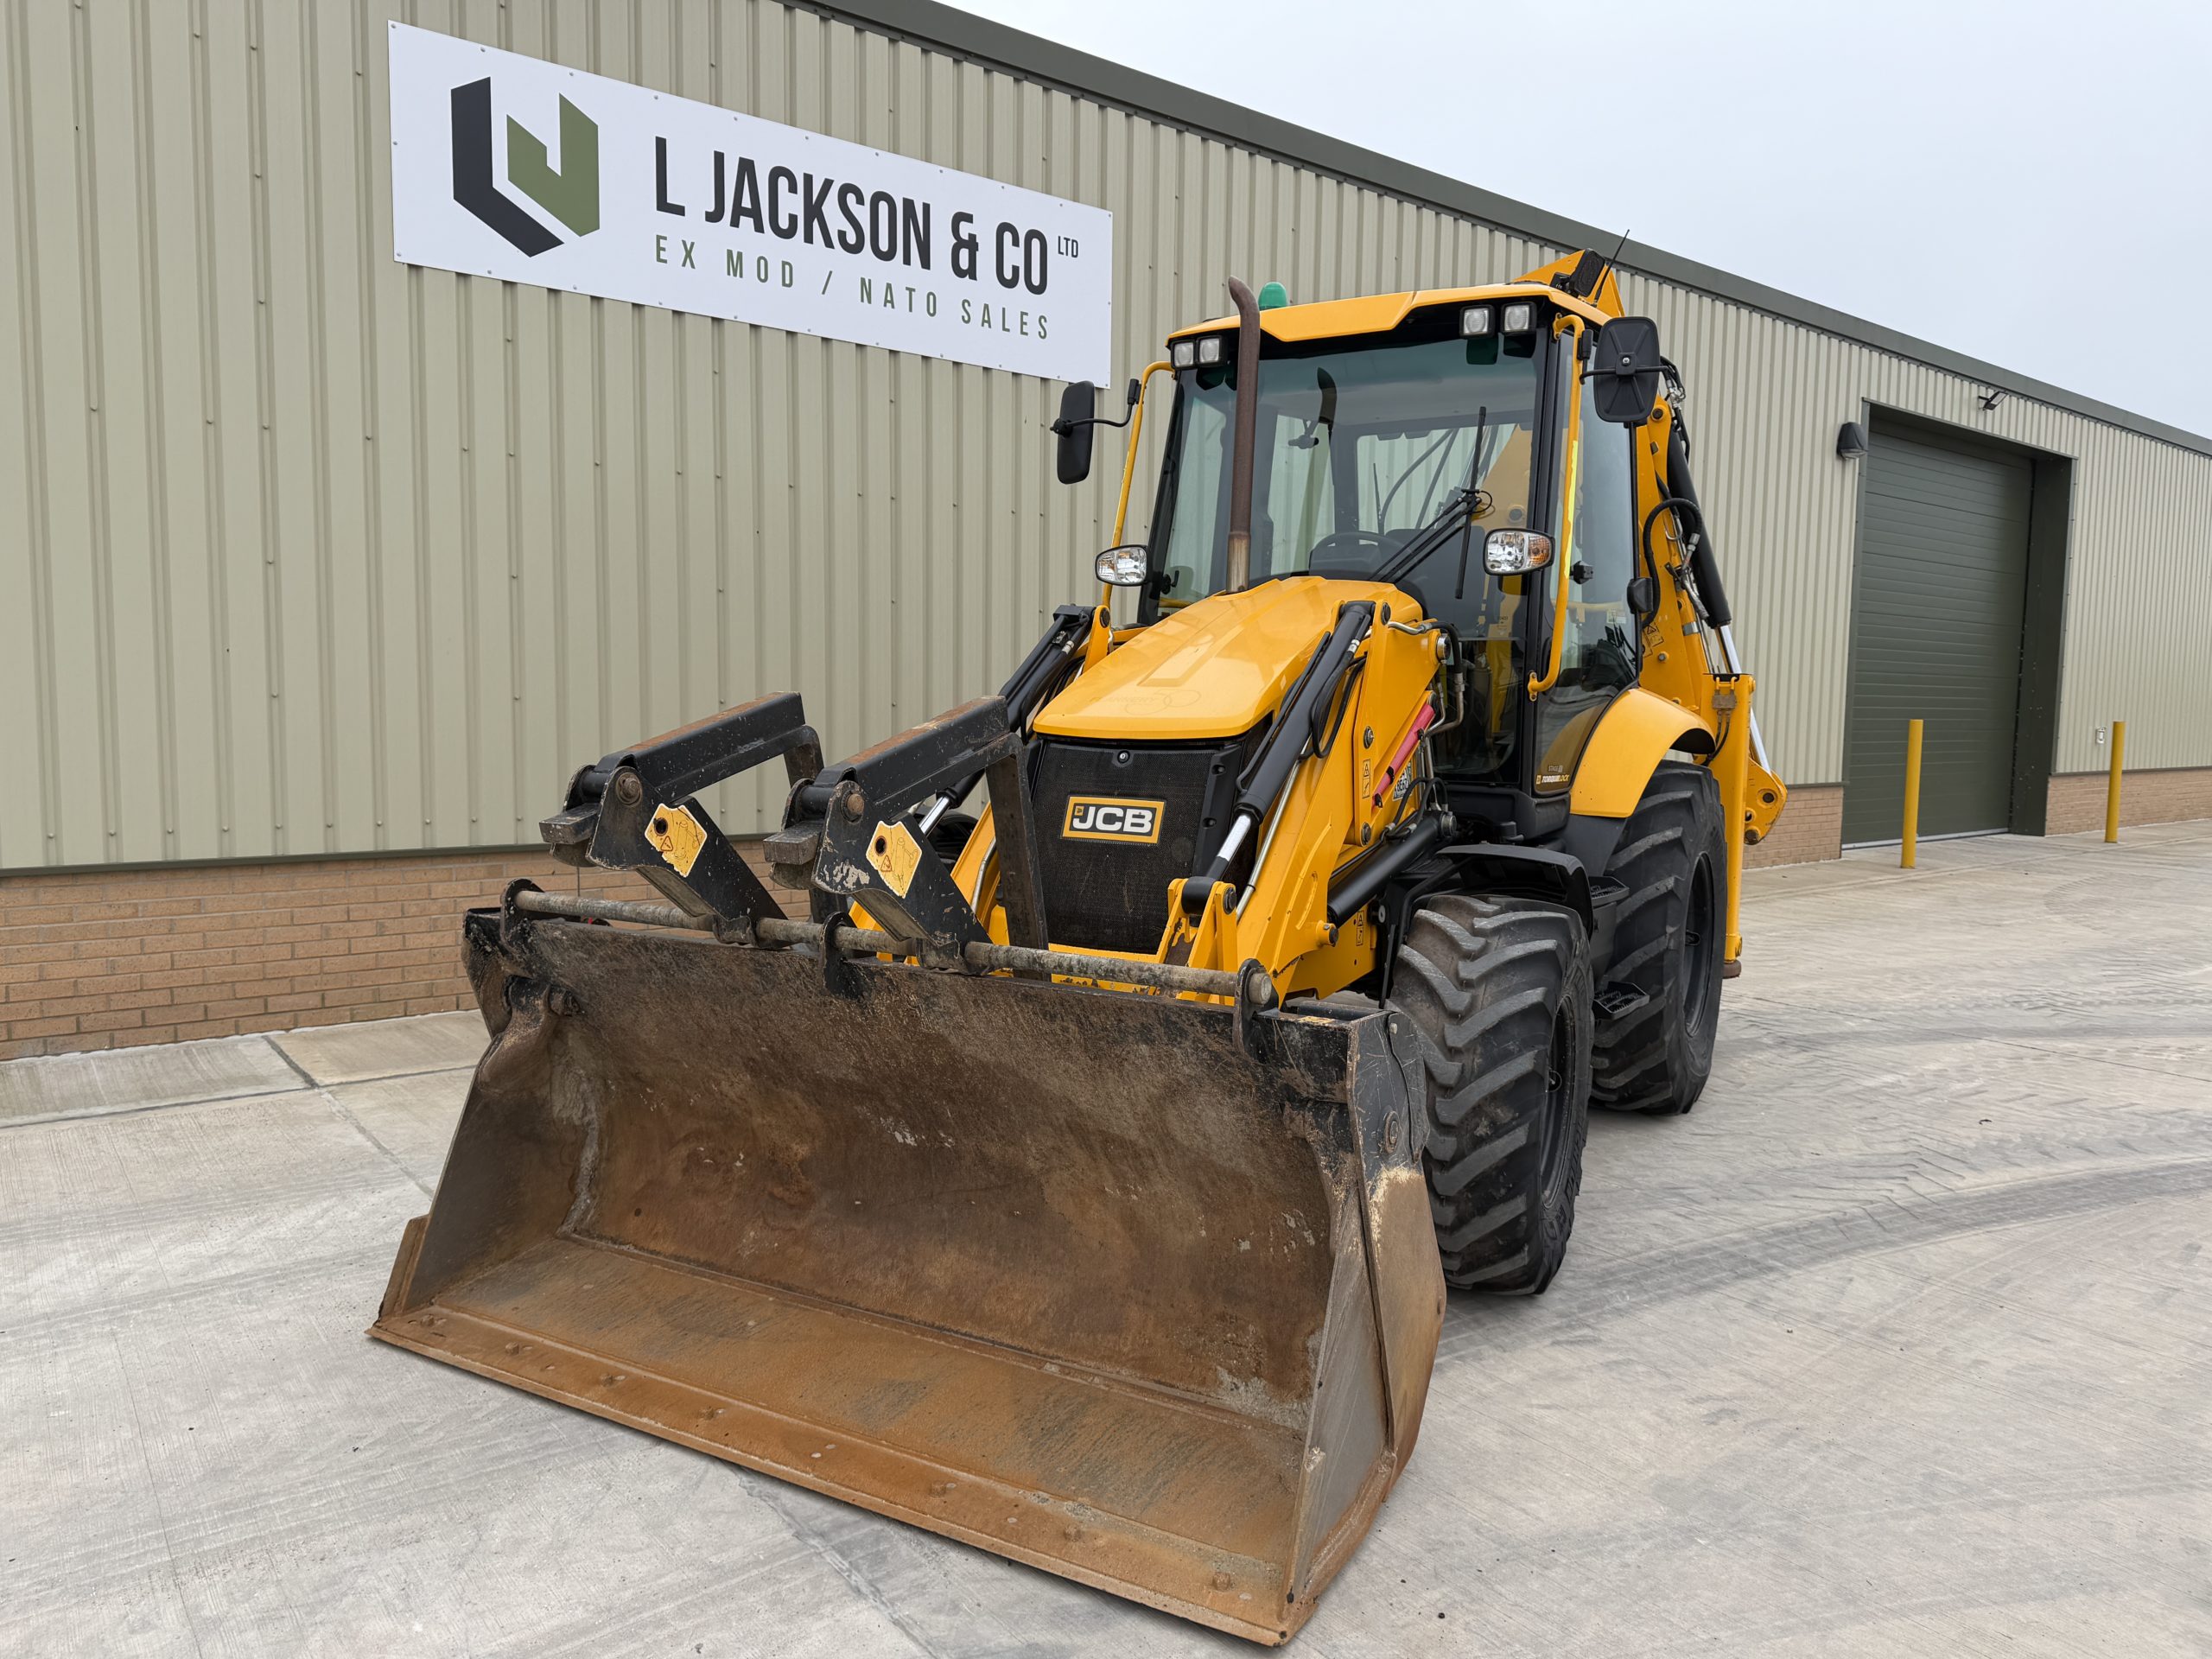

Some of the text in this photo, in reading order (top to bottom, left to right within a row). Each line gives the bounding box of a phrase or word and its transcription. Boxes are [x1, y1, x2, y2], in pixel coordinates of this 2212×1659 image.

[655, 136, 1079, 296] L JACKSON & CO LTD
[656, 234, 696, 270] EX
[726, 248, 794, 289] MOD
[860, 276, 937, 317] NATO
[961, 298, 1048, 340] SALES
[1072, 806, 1153, 833] JCB
